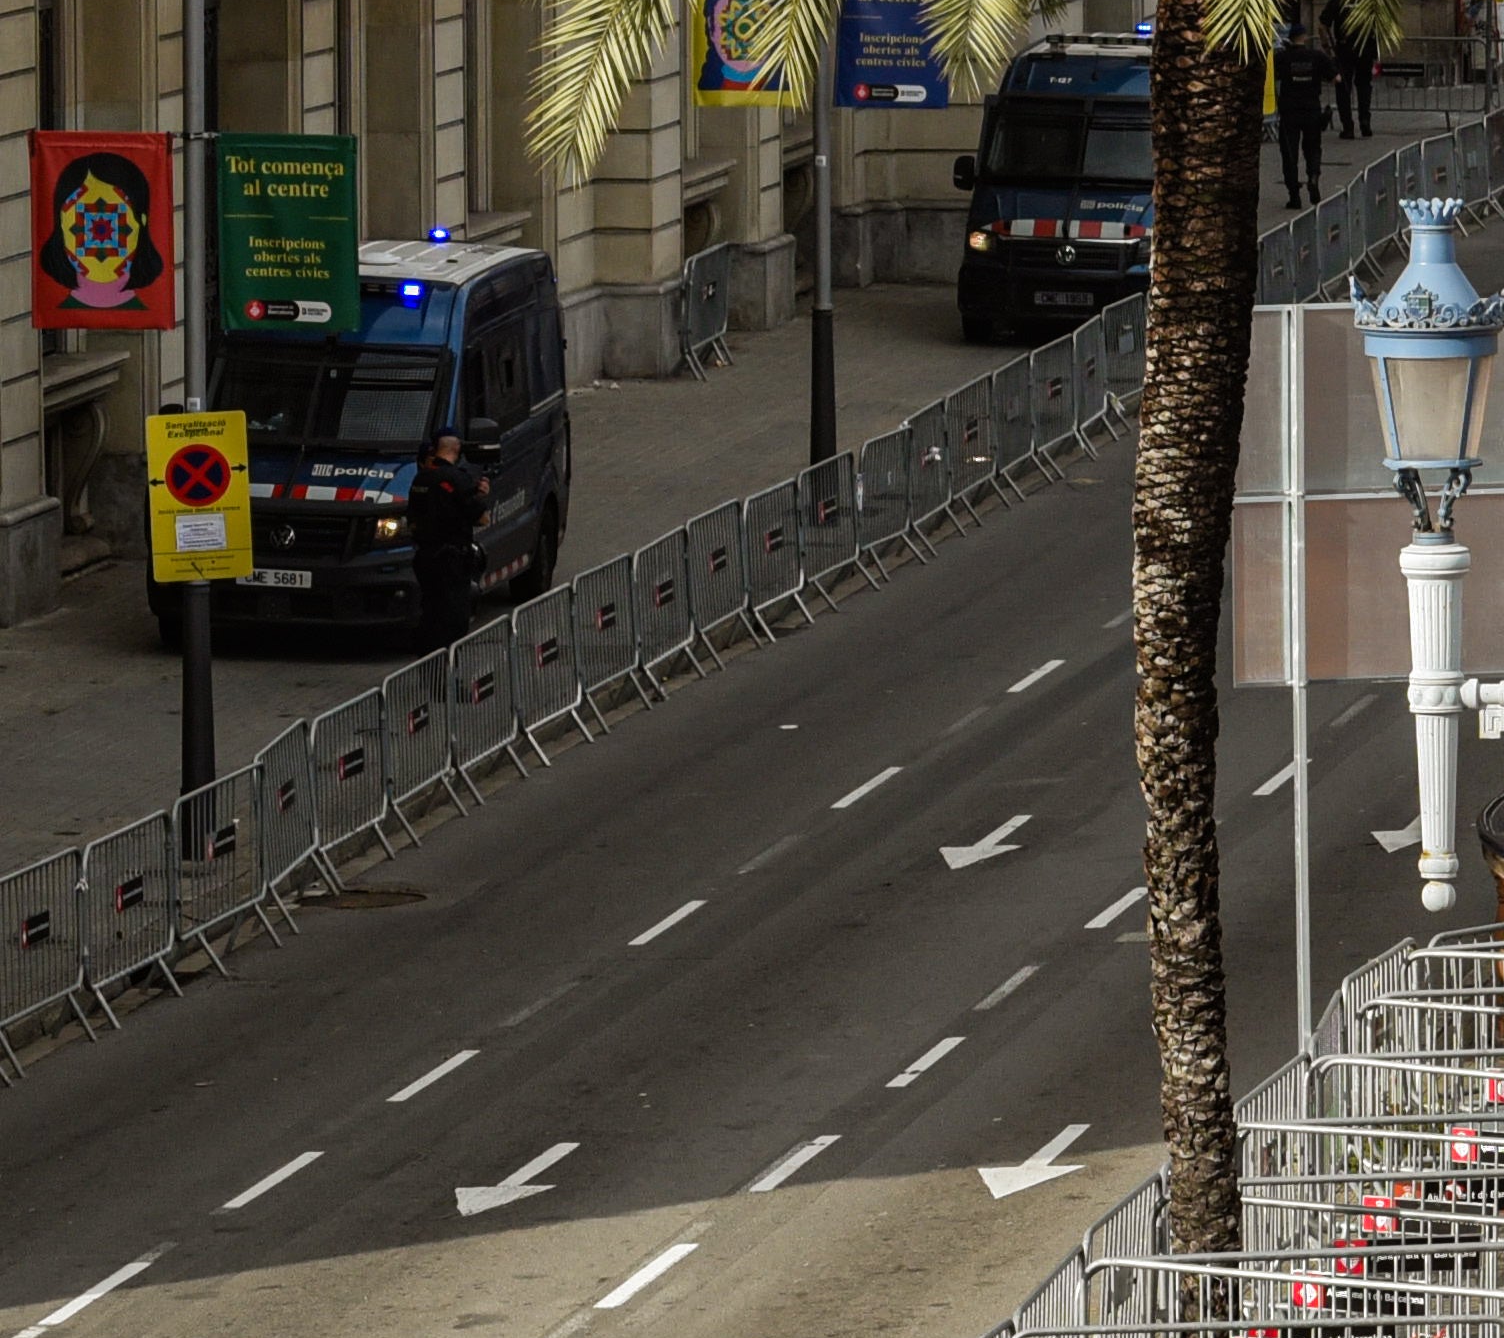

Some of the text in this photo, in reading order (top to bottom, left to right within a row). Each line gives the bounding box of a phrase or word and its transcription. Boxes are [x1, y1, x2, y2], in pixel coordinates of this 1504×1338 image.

[863, 46, 920, 56] obertes als
[855, 57, 927, 68] centres cívics
[226, 155, 345, 180] Tot comença
[243, 179, 330, 199] al centre
[1096, 201, 1145, 212] policia
[249, 236, 326, 253] Inscripcions
[253, 252, 322, 266] obertes als
[246, 267, 331, 280] centres cívics
[334, 467, 396, 480] policia
[275, 572, 305, 586] 5681
